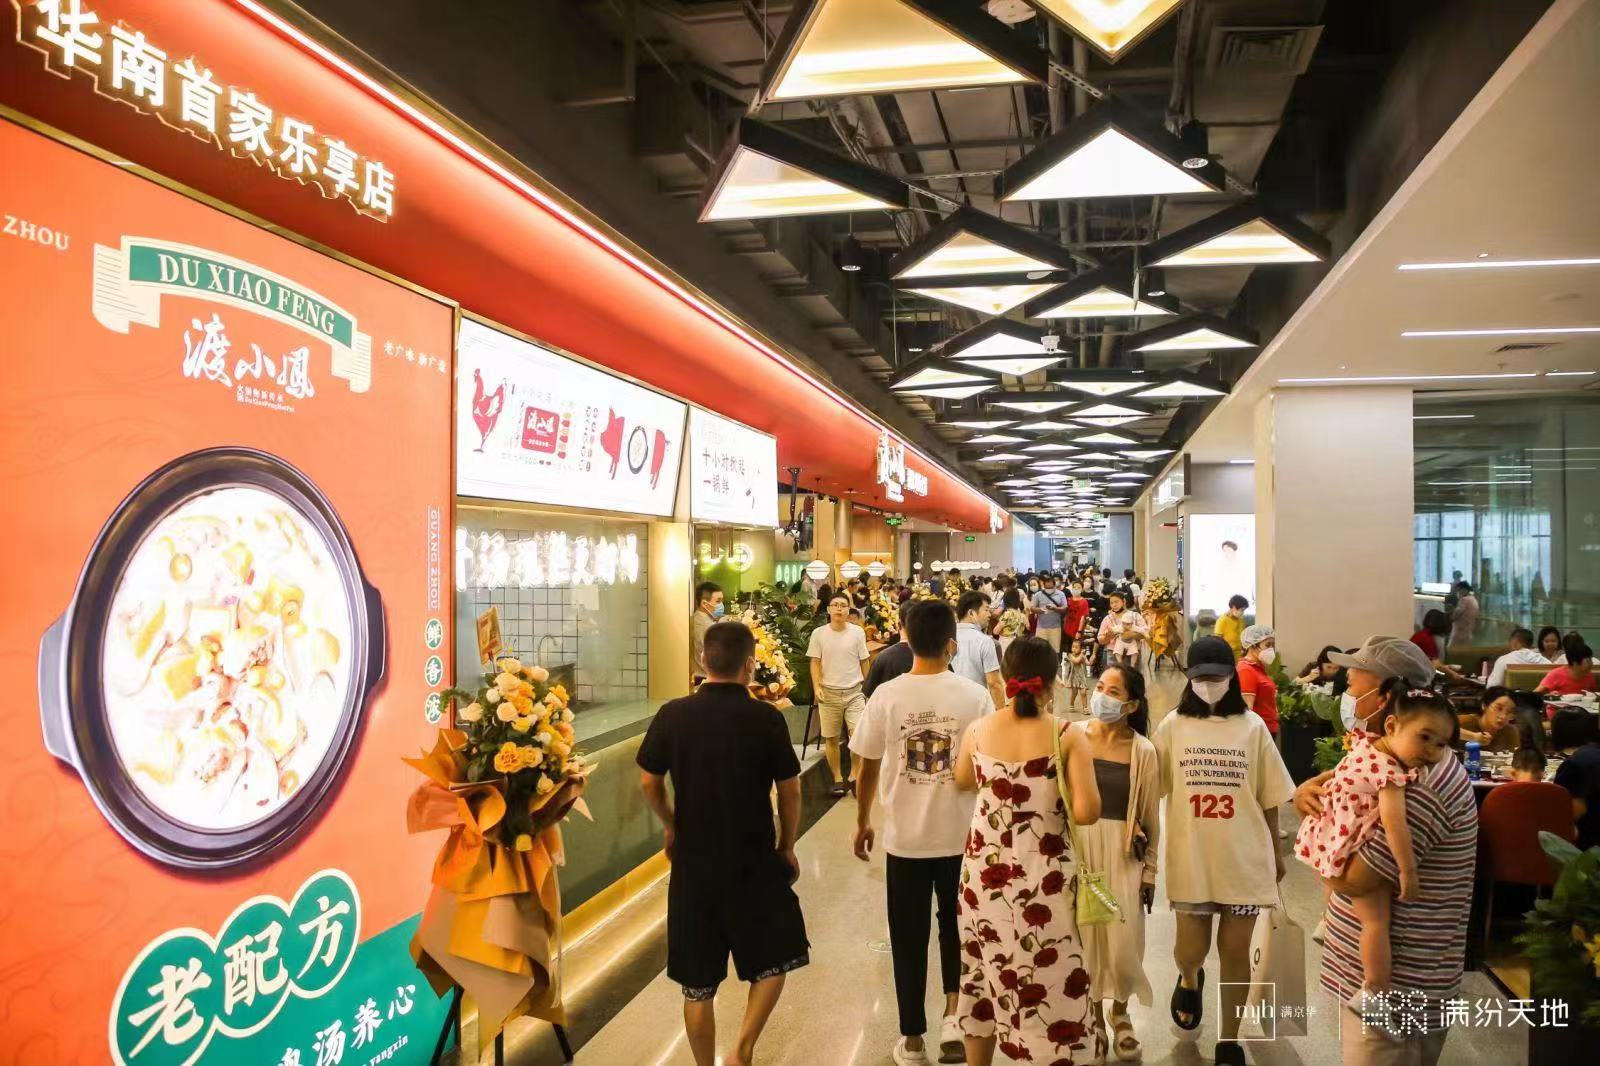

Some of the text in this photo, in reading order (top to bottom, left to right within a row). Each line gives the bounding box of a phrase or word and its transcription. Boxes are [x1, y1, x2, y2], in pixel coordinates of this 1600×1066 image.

[36, 0, 396, 217] 华南首家乐享店
[2, 214, 70, 252] ZHOU
[158, 253, 336, 336] DU XIAO FENG
[429, 509, 439, 610] GUANG ZHOU
[1193, 747, 1206, 755] LOS
[1207, 748, 1246, 757] OCHENTAS
[1203, 758, 1218, 767] ERA
[1219, 759, 1228, 767] EL
[1189, 769, 1201, 777] UN
[1189, 793, 1235, 820] 123
[128, 895, 351, 1059] 老配方
